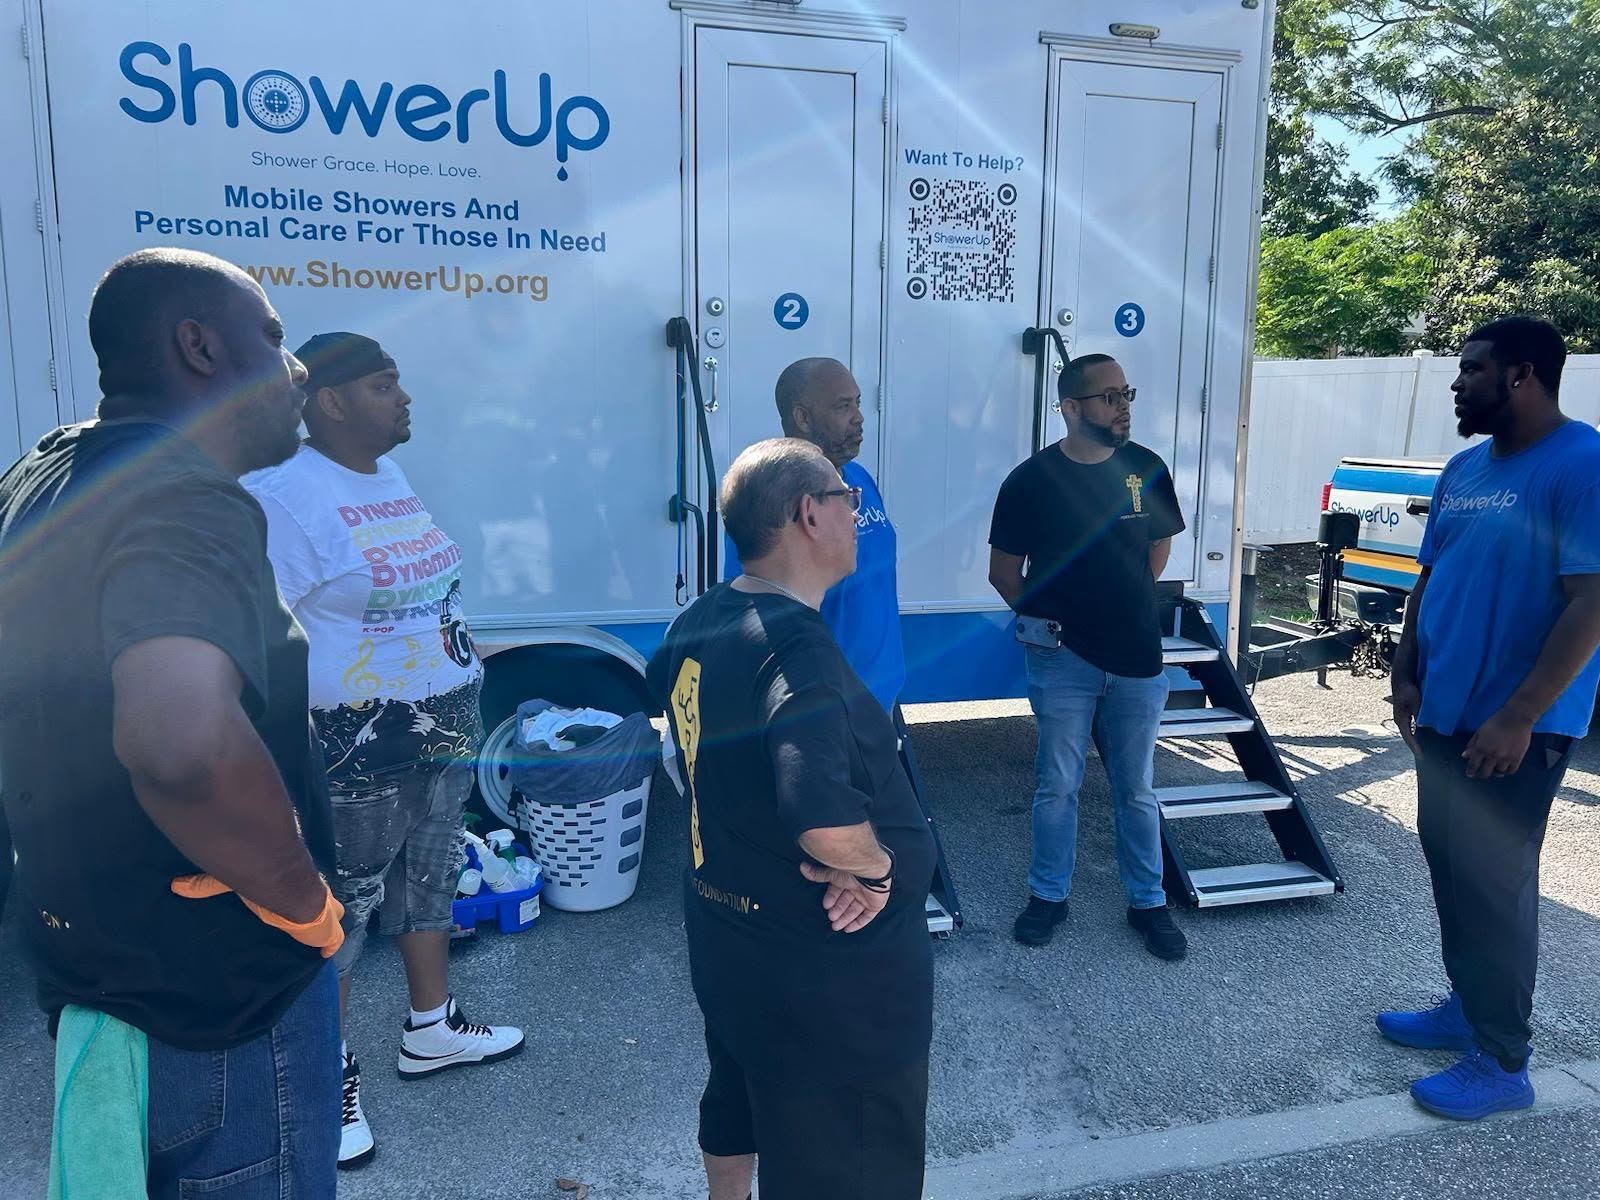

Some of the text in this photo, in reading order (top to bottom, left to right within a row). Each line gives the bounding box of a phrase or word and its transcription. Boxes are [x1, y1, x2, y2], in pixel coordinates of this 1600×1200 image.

[119, 41, 610, 164] ShowerUp
[251, 151, 481, 178] Shower Grace. Hope. Love.
[905, 149, 1024, 174] Want To Help?
[224, 185, 519, 221] Mobile Showers And
[135, 210, 606, 252] Personal Care For Those In Need
[934, 232, 991, 248] ShowerUp
[238, 260, 548, 301] ww.ShowerUp.org
[783, 299, 801, 323] 2
[1122, 308, 1138, 331] 3
